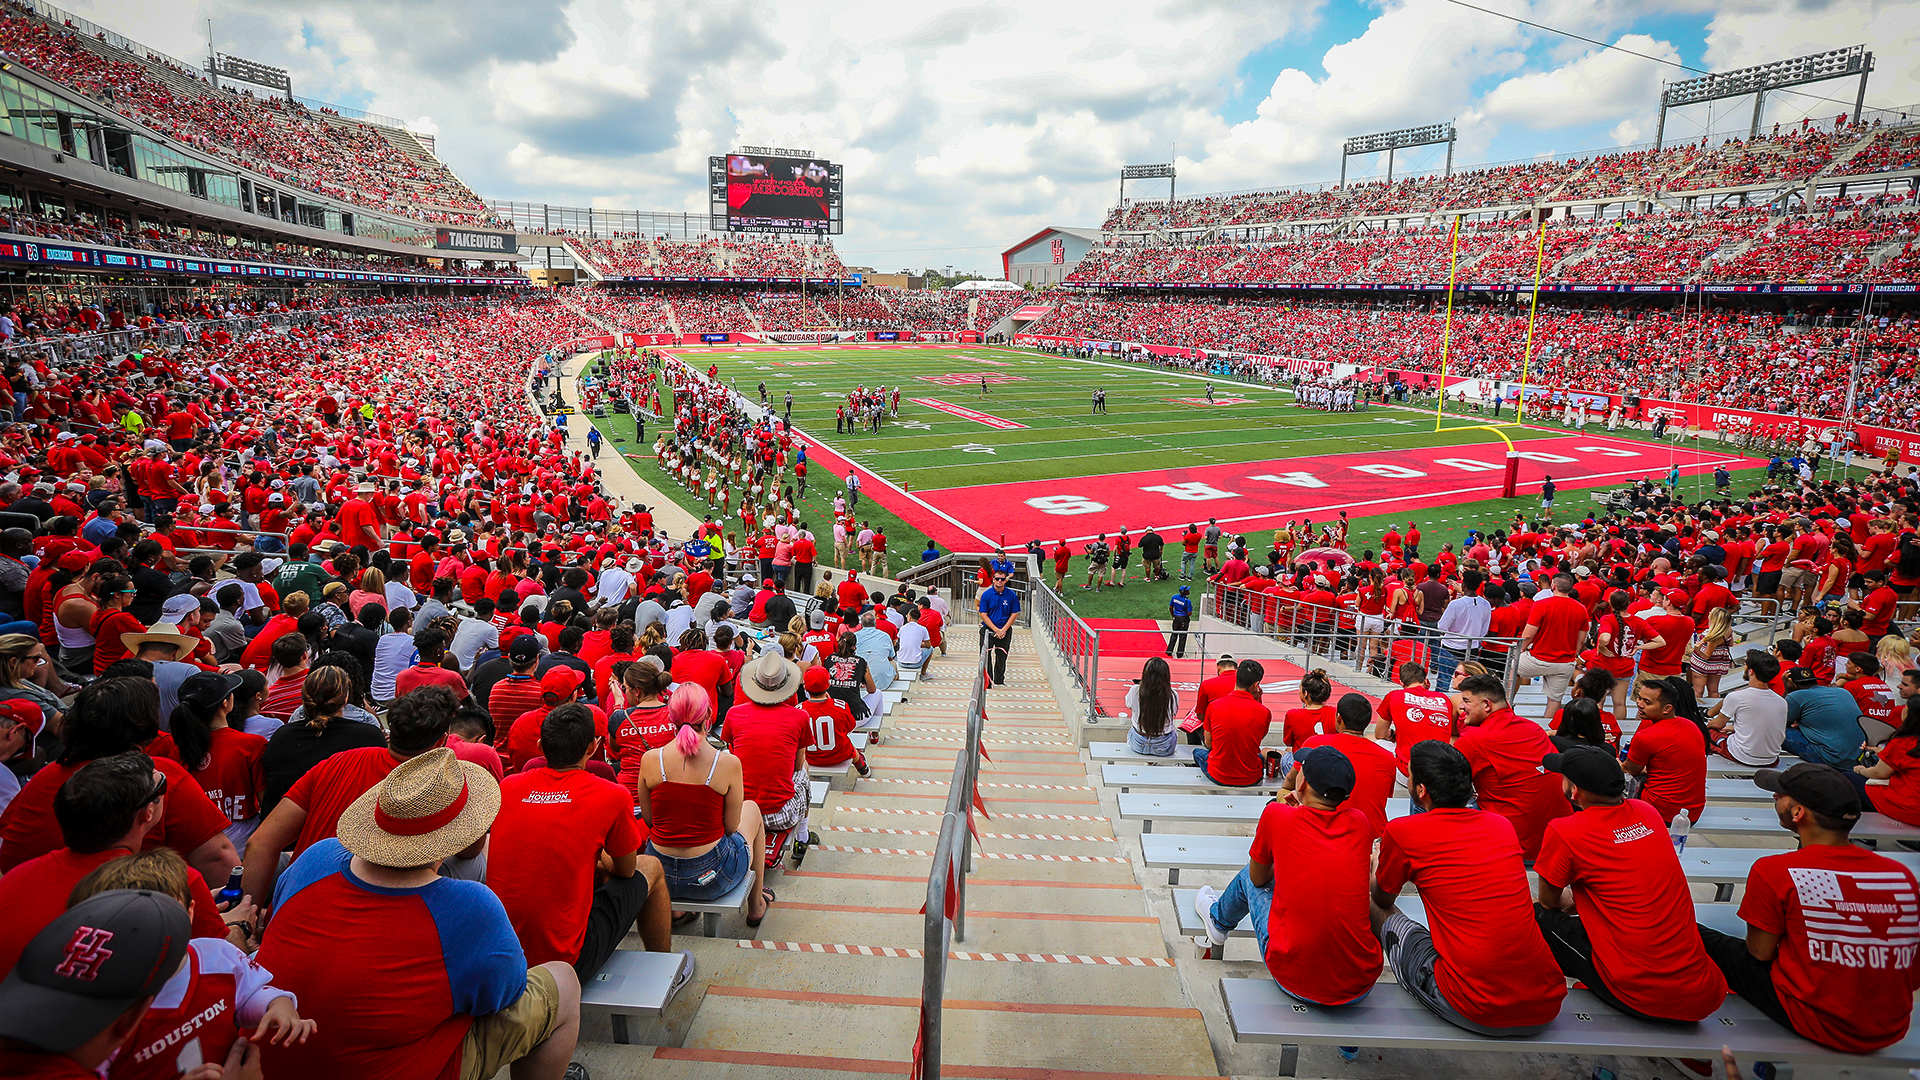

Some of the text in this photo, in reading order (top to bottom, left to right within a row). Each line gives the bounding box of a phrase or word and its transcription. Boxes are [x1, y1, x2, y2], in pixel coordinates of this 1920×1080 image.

[775, 148, 812, 158] STADIUM
[449, 233, 504, 250] TAKEOVER
[1876, 435, 1905, 449] TDECU
[279, 563, 309, 572] JUST
[1404, 692, 1446, 706] HR&P
[204, 788, 223, 799] MED
[528, 793, 569, 801] HOUSTON
[1614, 824, 1648, 840] HOUSTON
[1835, 901, 1898, 914] HOUSTON COUGARS
[1808, 939, 1919, 969] CLASS OF 20
[134, 998, 226, 1063] HOUSTON
